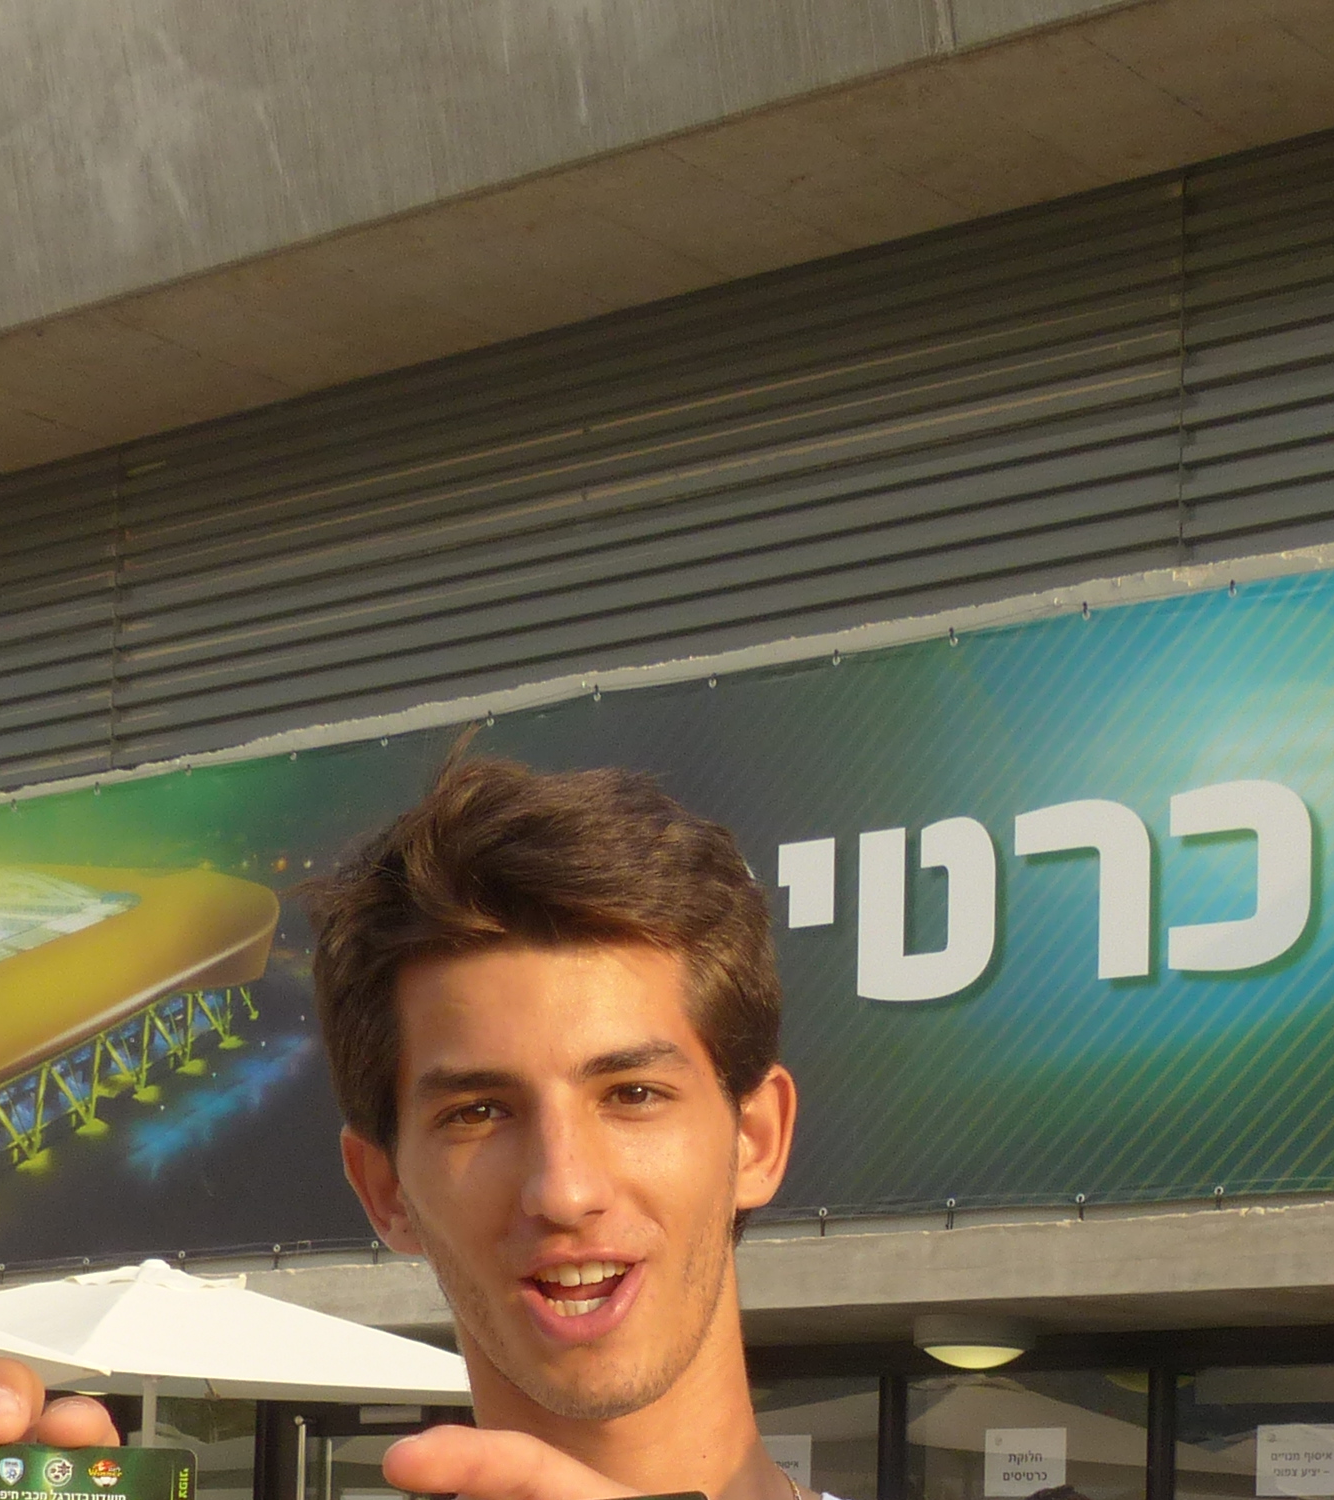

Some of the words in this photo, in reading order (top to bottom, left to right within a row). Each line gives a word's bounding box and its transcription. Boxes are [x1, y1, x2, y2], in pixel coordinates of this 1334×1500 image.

[749, 778, 1312, 1003] כרטי
[1008, 1451, 1043, 1465] חלוקת
[1304, 1451, 1333, 1463] איסוף
[1002, 1470, 1048, 1482] כרטיסים
[1273, 1467, 1298, 1478] צפוני
[1300, 1467, 1321, 1478] יציע
[21, 1491, 47, 1500] מכבי
